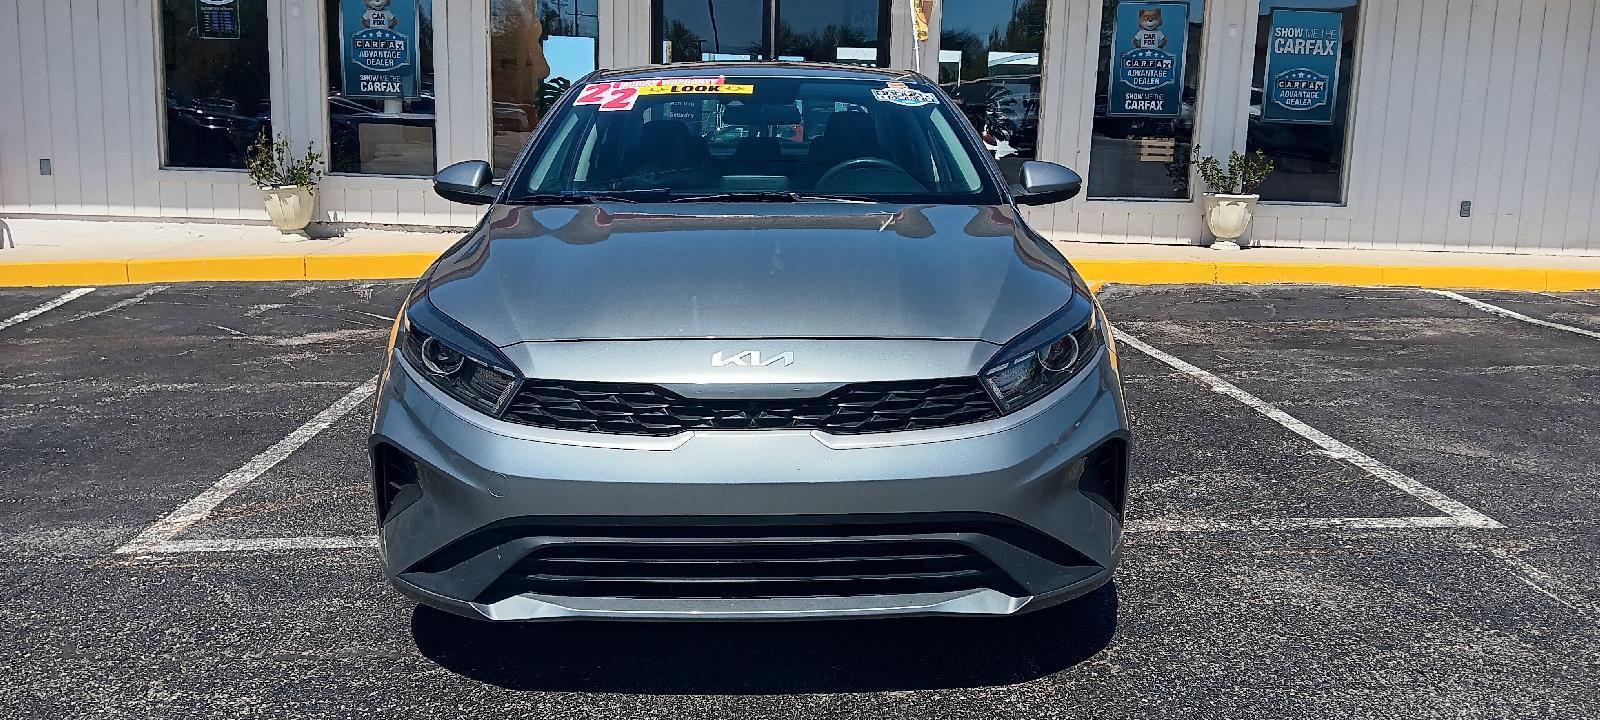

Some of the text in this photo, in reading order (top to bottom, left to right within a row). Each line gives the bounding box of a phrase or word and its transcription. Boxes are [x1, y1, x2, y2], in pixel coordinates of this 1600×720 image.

[1275, 27, 1337, 39] SHOW ME THE
[355, 40, 404, 50] CARFAX
[1274, 38, 1337, 55] CARFAX
[358, 51, 401, 59] ADVANTAGE
[366, 58, 394, 66] DEALER
[1125, 59, 1172, 69] CARFAX
[1127, 69, 1167, 78] ADVANTAGE
[1133, 77, 1160, 85] DEALER
[1278, 80, 1324, 90] CARFAX
[360, 81, 402, 92] CARFAX
[670, 85, 720, 93] LOOK
[1125, 92, 1143, 100] SHOW
[1279, 91, 1319, 99] ADVANTAGE
[1124, 100, 1165, 111] CARFAX
[1285, 98, 1312, 106] DEALER
[711, 350, 794, 367] KIA
